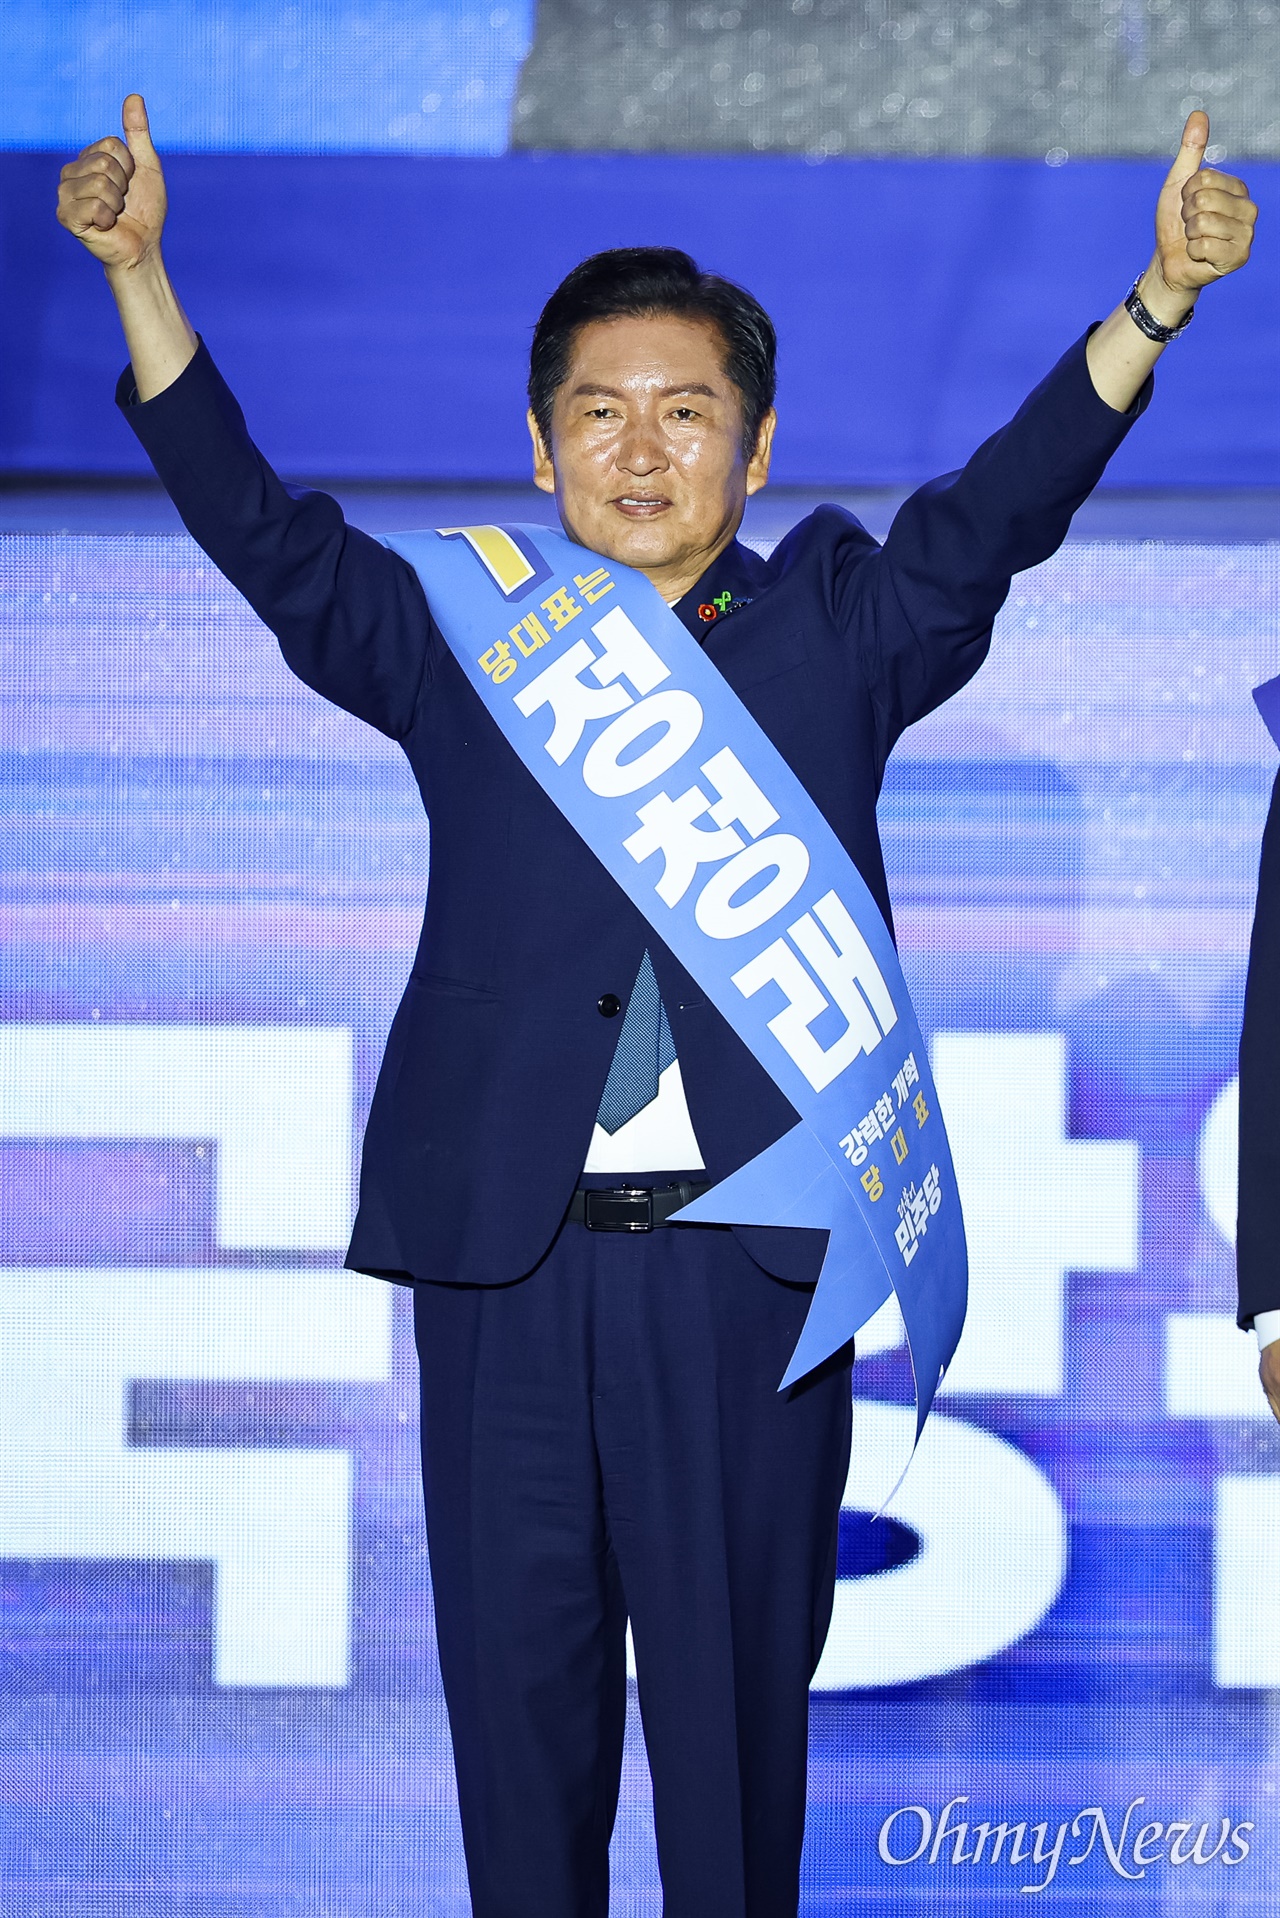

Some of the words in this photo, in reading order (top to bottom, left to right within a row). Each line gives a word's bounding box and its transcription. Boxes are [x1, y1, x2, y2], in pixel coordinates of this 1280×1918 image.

[477, 567, 616, 684] 당대표는
[512, 604, 898, 1094] 정청래
[838, 1091, 897, 1167] 강력한
[891, 1051, 920, 1110] 개혁
[894, 1162, 942, 1268] 민주당
